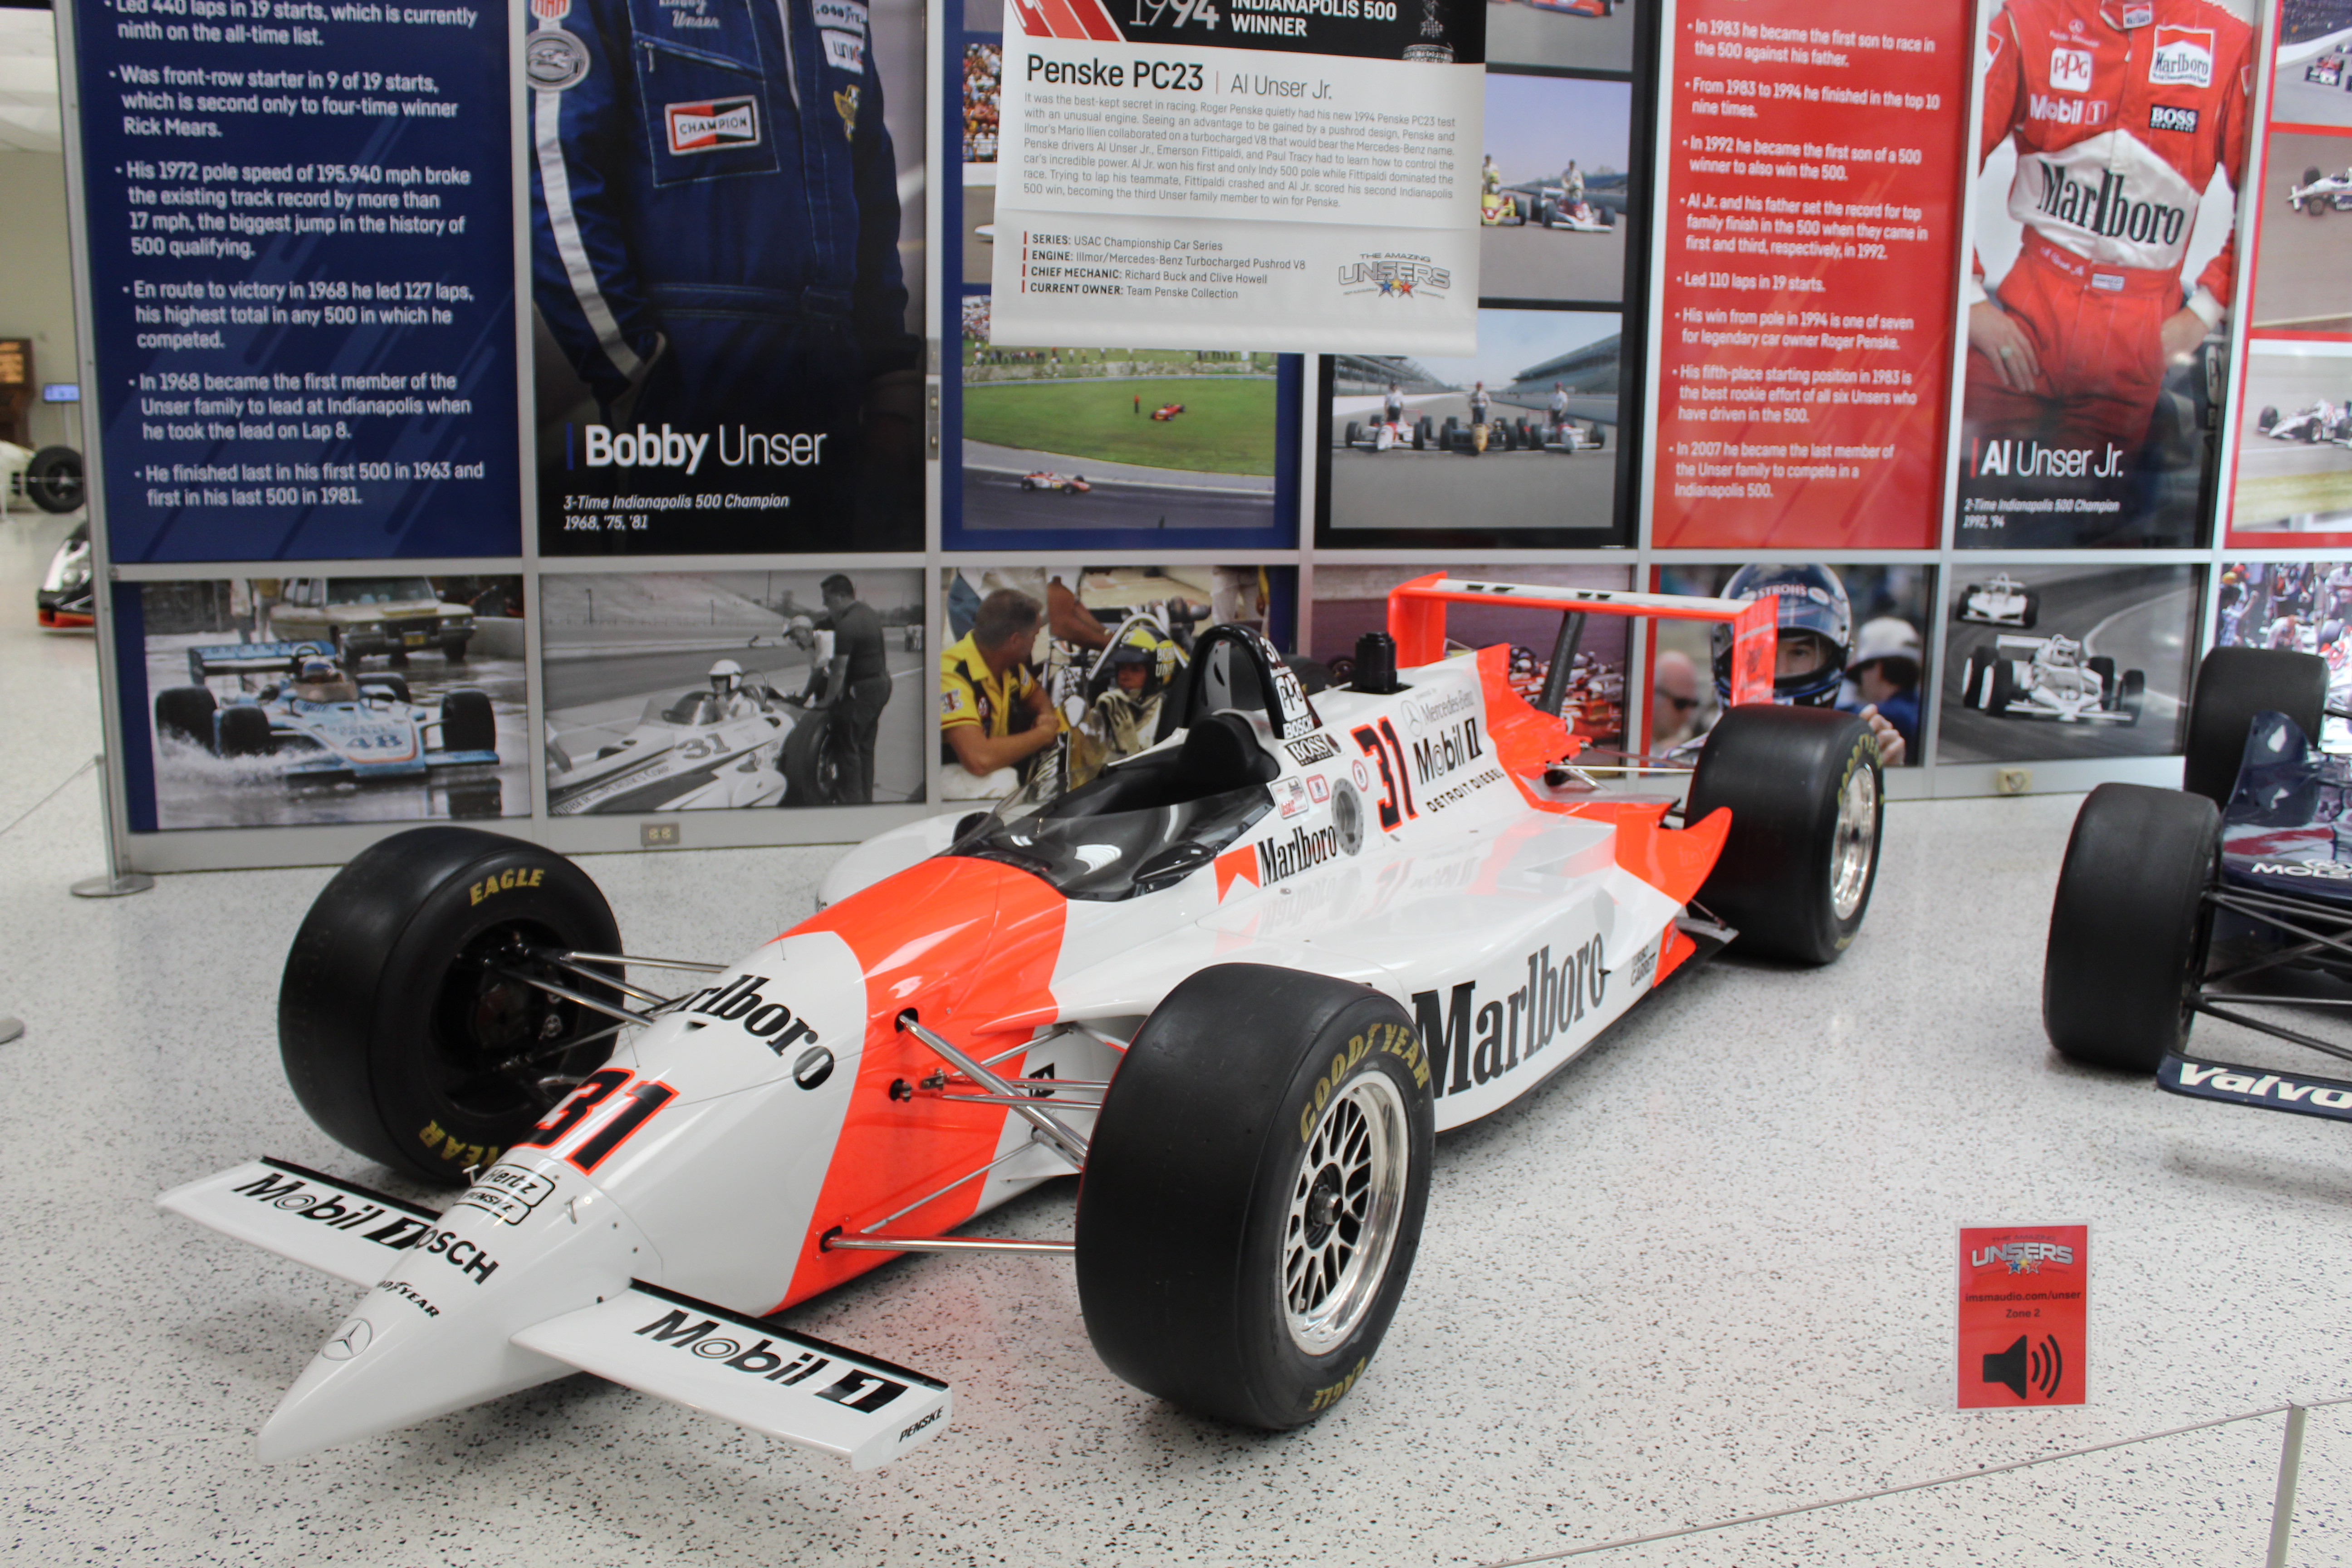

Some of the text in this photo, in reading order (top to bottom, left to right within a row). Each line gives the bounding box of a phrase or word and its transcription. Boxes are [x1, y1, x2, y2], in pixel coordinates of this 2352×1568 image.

[1363, 1, 1397, 21] 500
[1231, 13, 1308, 37] WINNER
[1695, 19, 1936, 53] In 1983 he became the first son to race in
[1028, 54, 1203, 91] Penske PC23
[2053, 53, 2089, 80] PPG
[2154, 51, 2209, 76] Marlboro
[1230, 74, 1332, 100] Al Unser Jr.
[2029, 93, 2085, 125] Mobil
[2151, 107, 2197, 127] BOSS
[678, 116, 748, 135] CHAMPION
[127, 161, 471, 187] His 1972 pole speed of 195.940 mph broke
[1024, 182, 1340, 208] 500 win, becoming the third Unser family member to win for Penske.
[2035, 158, 2185, 246] Marlboro
[1032, 233, 1222, 251] SERIES: USAC Championship Car Series
[1032, 250, 1073, 262] ENGINE:
[1186, 256, 1250, 268] Turbocharged
[1253, 258, 1291, 270] Pushrod
[1294, 260, 1305, 270] V8
[1384, 252, 1431, 262] AMAZING
[1031, 266, 1267, 284] CHIEF MECHANIC: Richard Buck and Clive Howell
[1338, 260, 1450, 289] UNSERS
[1684, 271, 1826, 292] Led 110 laps in 19 starts.
[1030, 282, 1238, 299] CURRENT OWNER: Team Penske Collection
[585, 423, 827, 475] Bobby Unser
[1980, 439, 2123, 478] Al Unser Jr.
[146, 461, 485, 483] He finished last in his first 500 in 1963 and
[563, 493, 789, 512] 3-Time Indianapolis 500 Champion
[1964, 498, 2120, 514] 2-Time Indianapolis 500 Champion
[564, 514, 647, 531] 1968, '75, '81
[1279, 681, 1303, 711] PPG
[1420, 689, 1474, 725] Mercedes-Benz
[1283, 714, 1315, 739] BOSCH
[675, 733, 731, 760] 31
[1289, 735, 1329, 761] BOSS
[1412, 724, 1465, 785] Mobil
[1350, 715, 1419, 833] 31
[1426, 768, 1505, 813] DETROIT DIESEL
[1257, 825, 1337, 887] Marlboro
[2251, 862, 2352, 880] MOLS
[469, 867, 544, 906] EAGLE
[1411, 932, 1606, 1100] Marlboro
[511, 1068, 680, 1176] 31
[481, 1169, 539, 1195] Hertz
[231, 1173, 385, 1231] Mobil
[1971, 1241, 2074, 1268] UNSERS
[1965, 1291, 2082, 1303] imsmaudio.com/unser
[2005, 1308, 2041, 1319] Zone 2
[632, 1308, 831, 1388] Mobil
[898, 1405, 945, 1444] PENSKE
